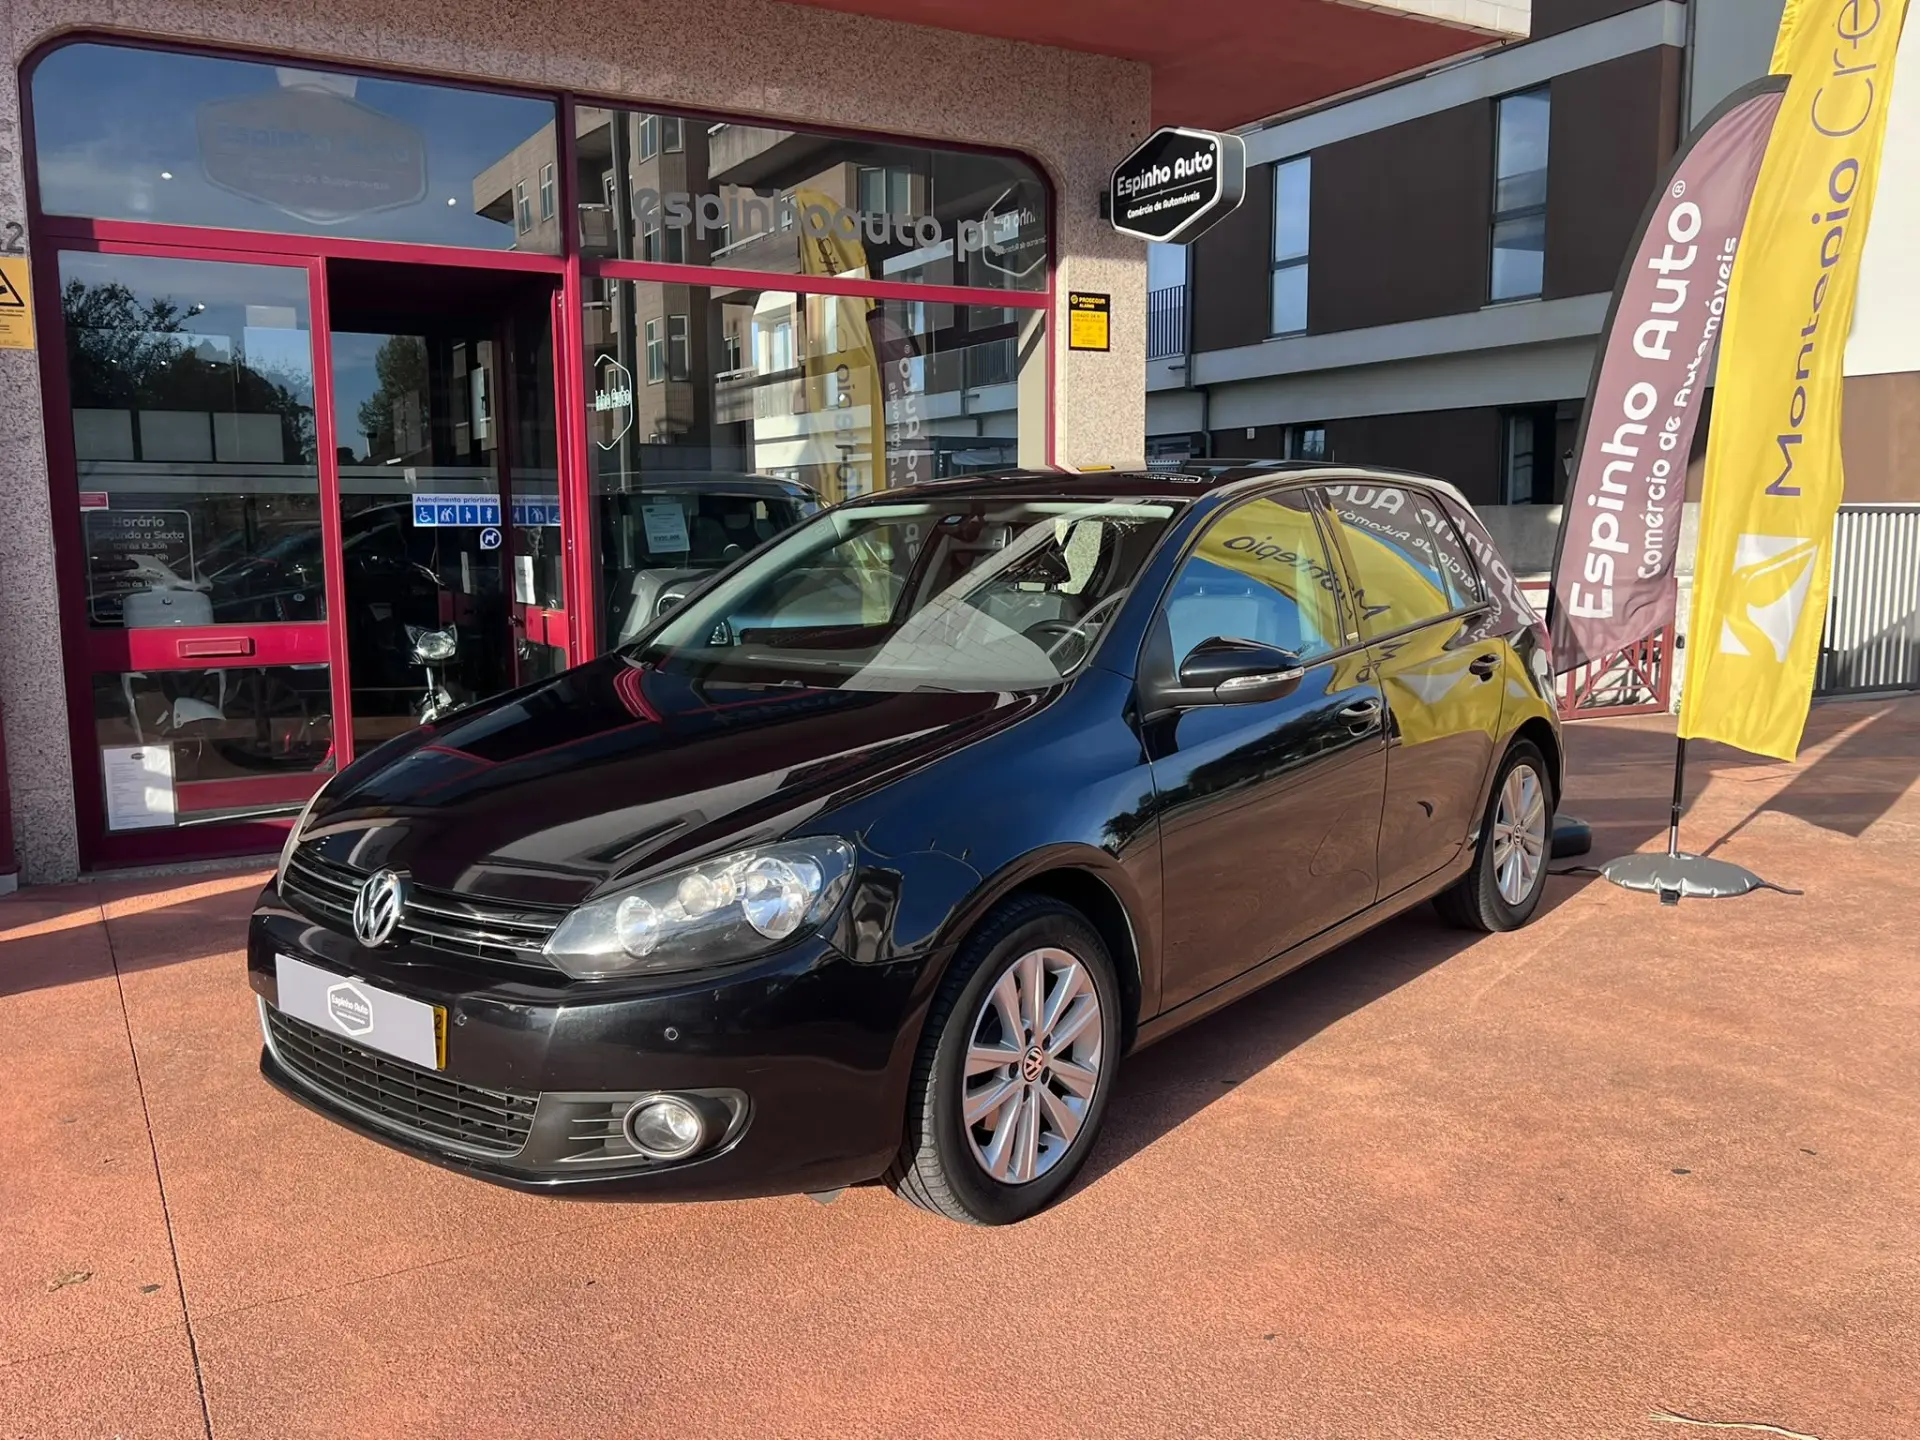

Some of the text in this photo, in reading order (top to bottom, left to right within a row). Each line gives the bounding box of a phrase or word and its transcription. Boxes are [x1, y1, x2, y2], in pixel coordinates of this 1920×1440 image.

[1117, 166, 1171, 197] Espinho
[1127, 190, 1201, 219] Comércio de Automóveis
[634, 183, 1000, 262] espinhoauto.pt
[1765, 158, 1859, 496] Montepio
[1637, 237, 1737, 579] Comércio de Automóveis
[113, 516, 165, 527] Horário
[1569, 381, 1658, 619] Espinho
